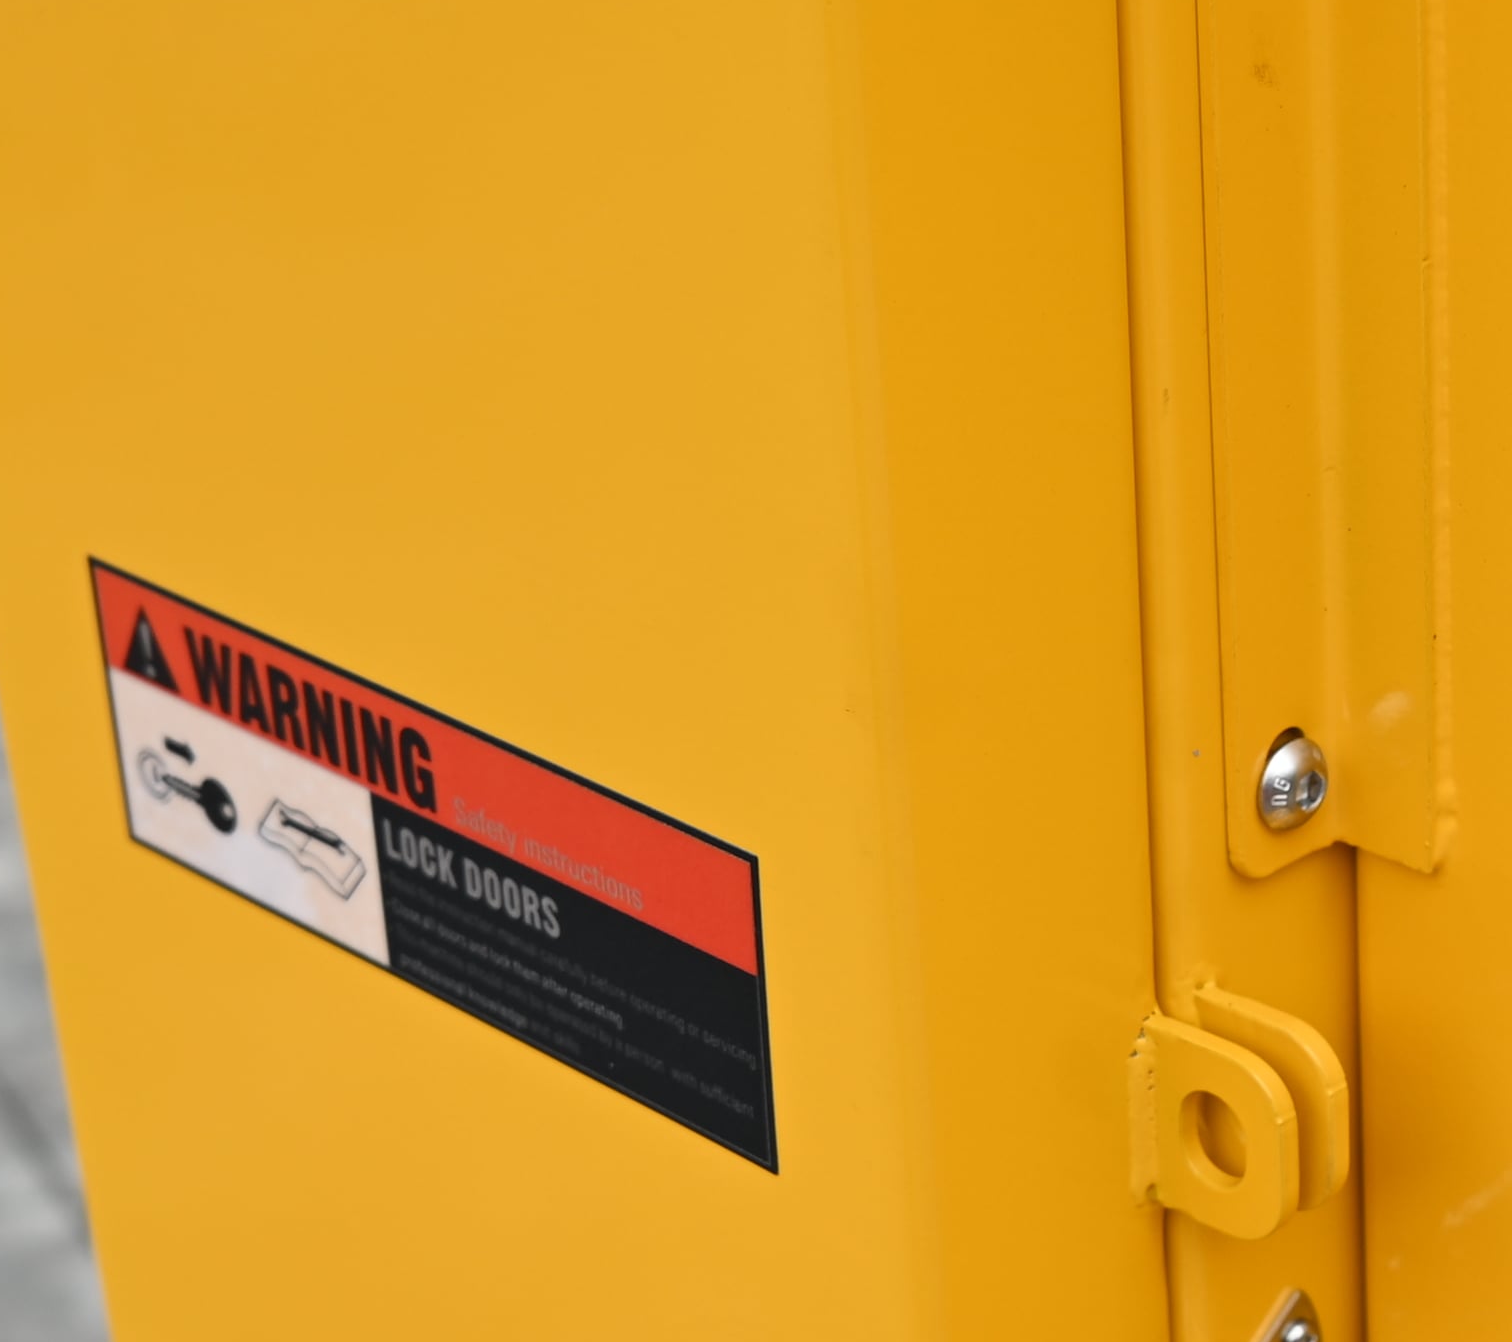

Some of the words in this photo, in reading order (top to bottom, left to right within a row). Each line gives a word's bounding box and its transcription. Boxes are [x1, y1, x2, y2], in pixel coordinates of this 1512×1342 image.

[182, 624, 438, 815] WARNING
[382, 817, 458, 890] LOCK
[461, 856, 561, 939] DOORS
[452, 795, 518, 855] Safety
[524, 835, 644, 912] instructions
[569, 990, 623, 1030] operating
[629, 992, 685, 1033] operating
[702, 1029, 756, 1069] servicing
